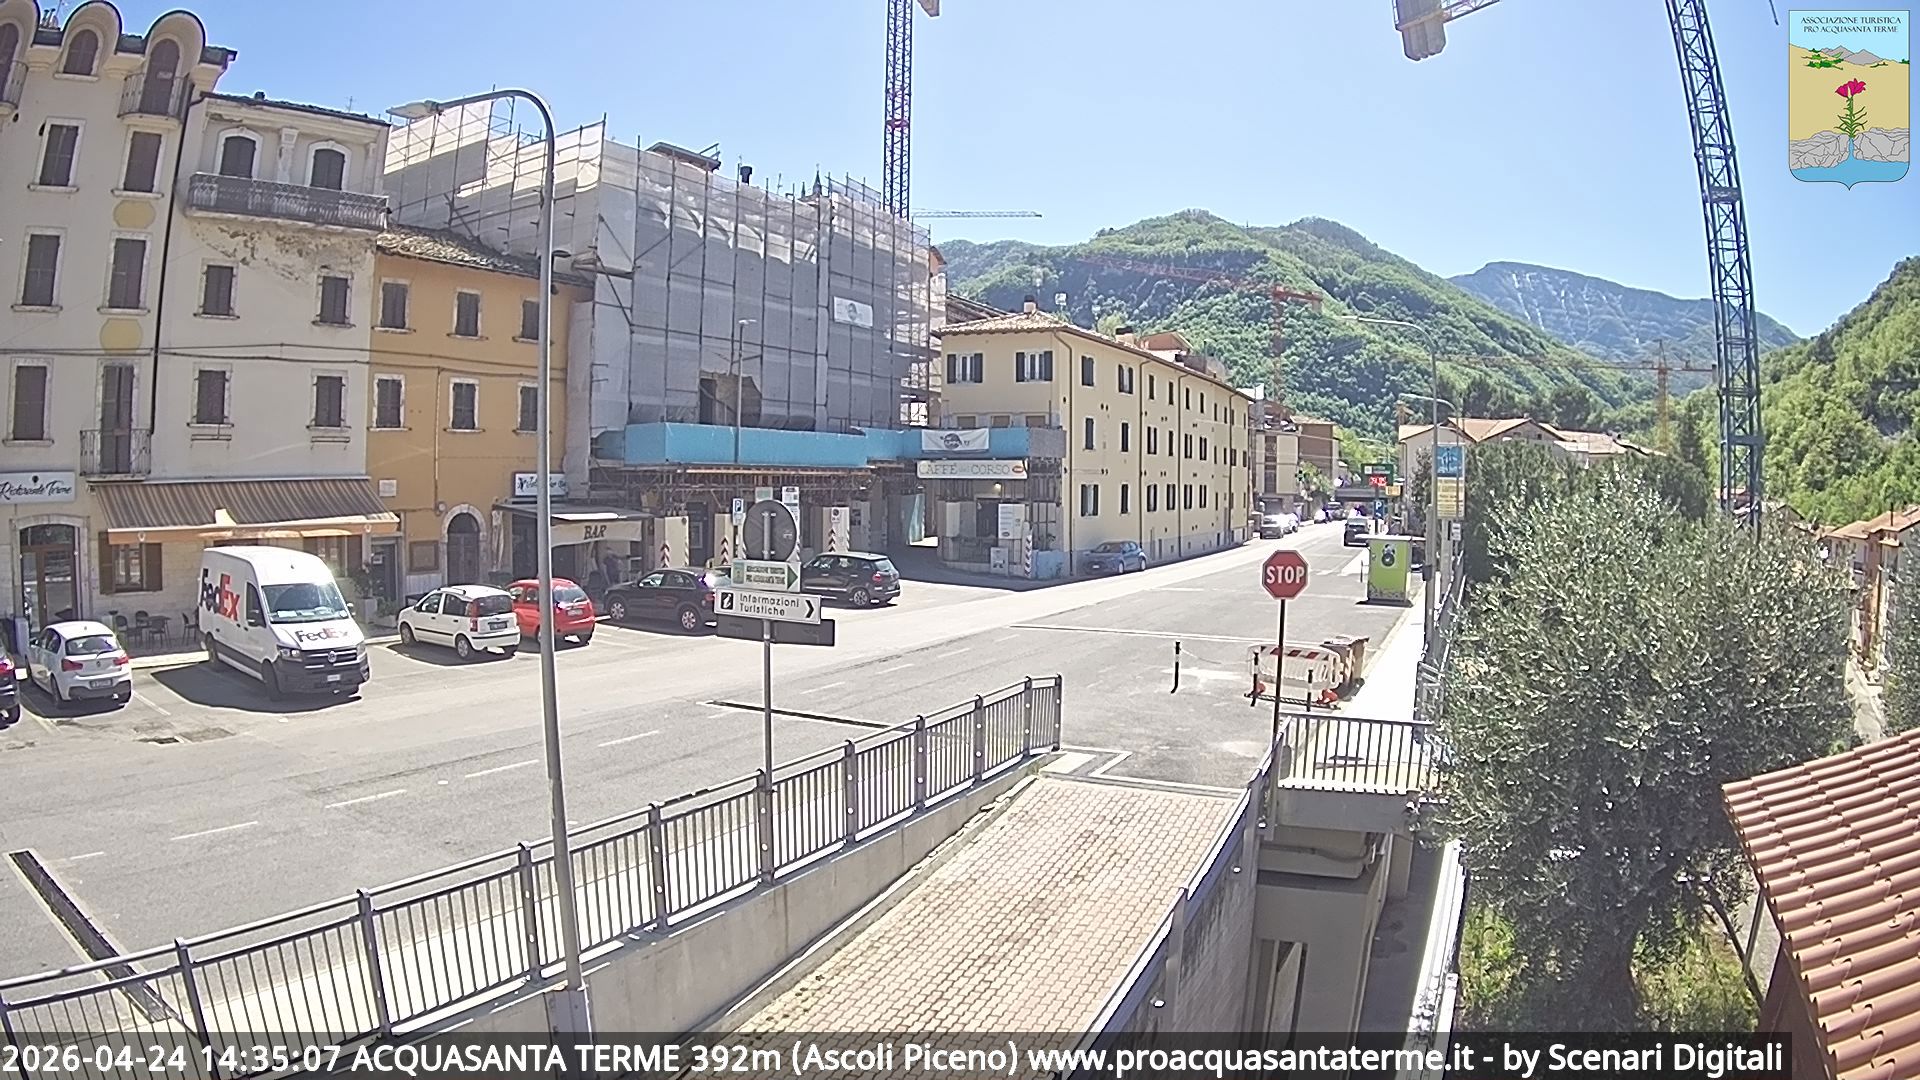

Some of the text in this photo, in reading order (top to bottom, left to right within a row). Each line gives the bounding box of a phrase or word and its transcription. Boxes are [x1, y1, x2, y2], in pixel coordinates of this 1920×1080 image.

[971, 464, 1010, 475] CORSO
[584, 525, 607, 540] BAR
[1265, 565, 1305, 584] STOP
[200, 567, 241, 622] FedEx
[740, 593, 800, 607] Informazioni
[740, 602, 785, 616] Turistiche
[295, 627, 349, 642] FedEx
